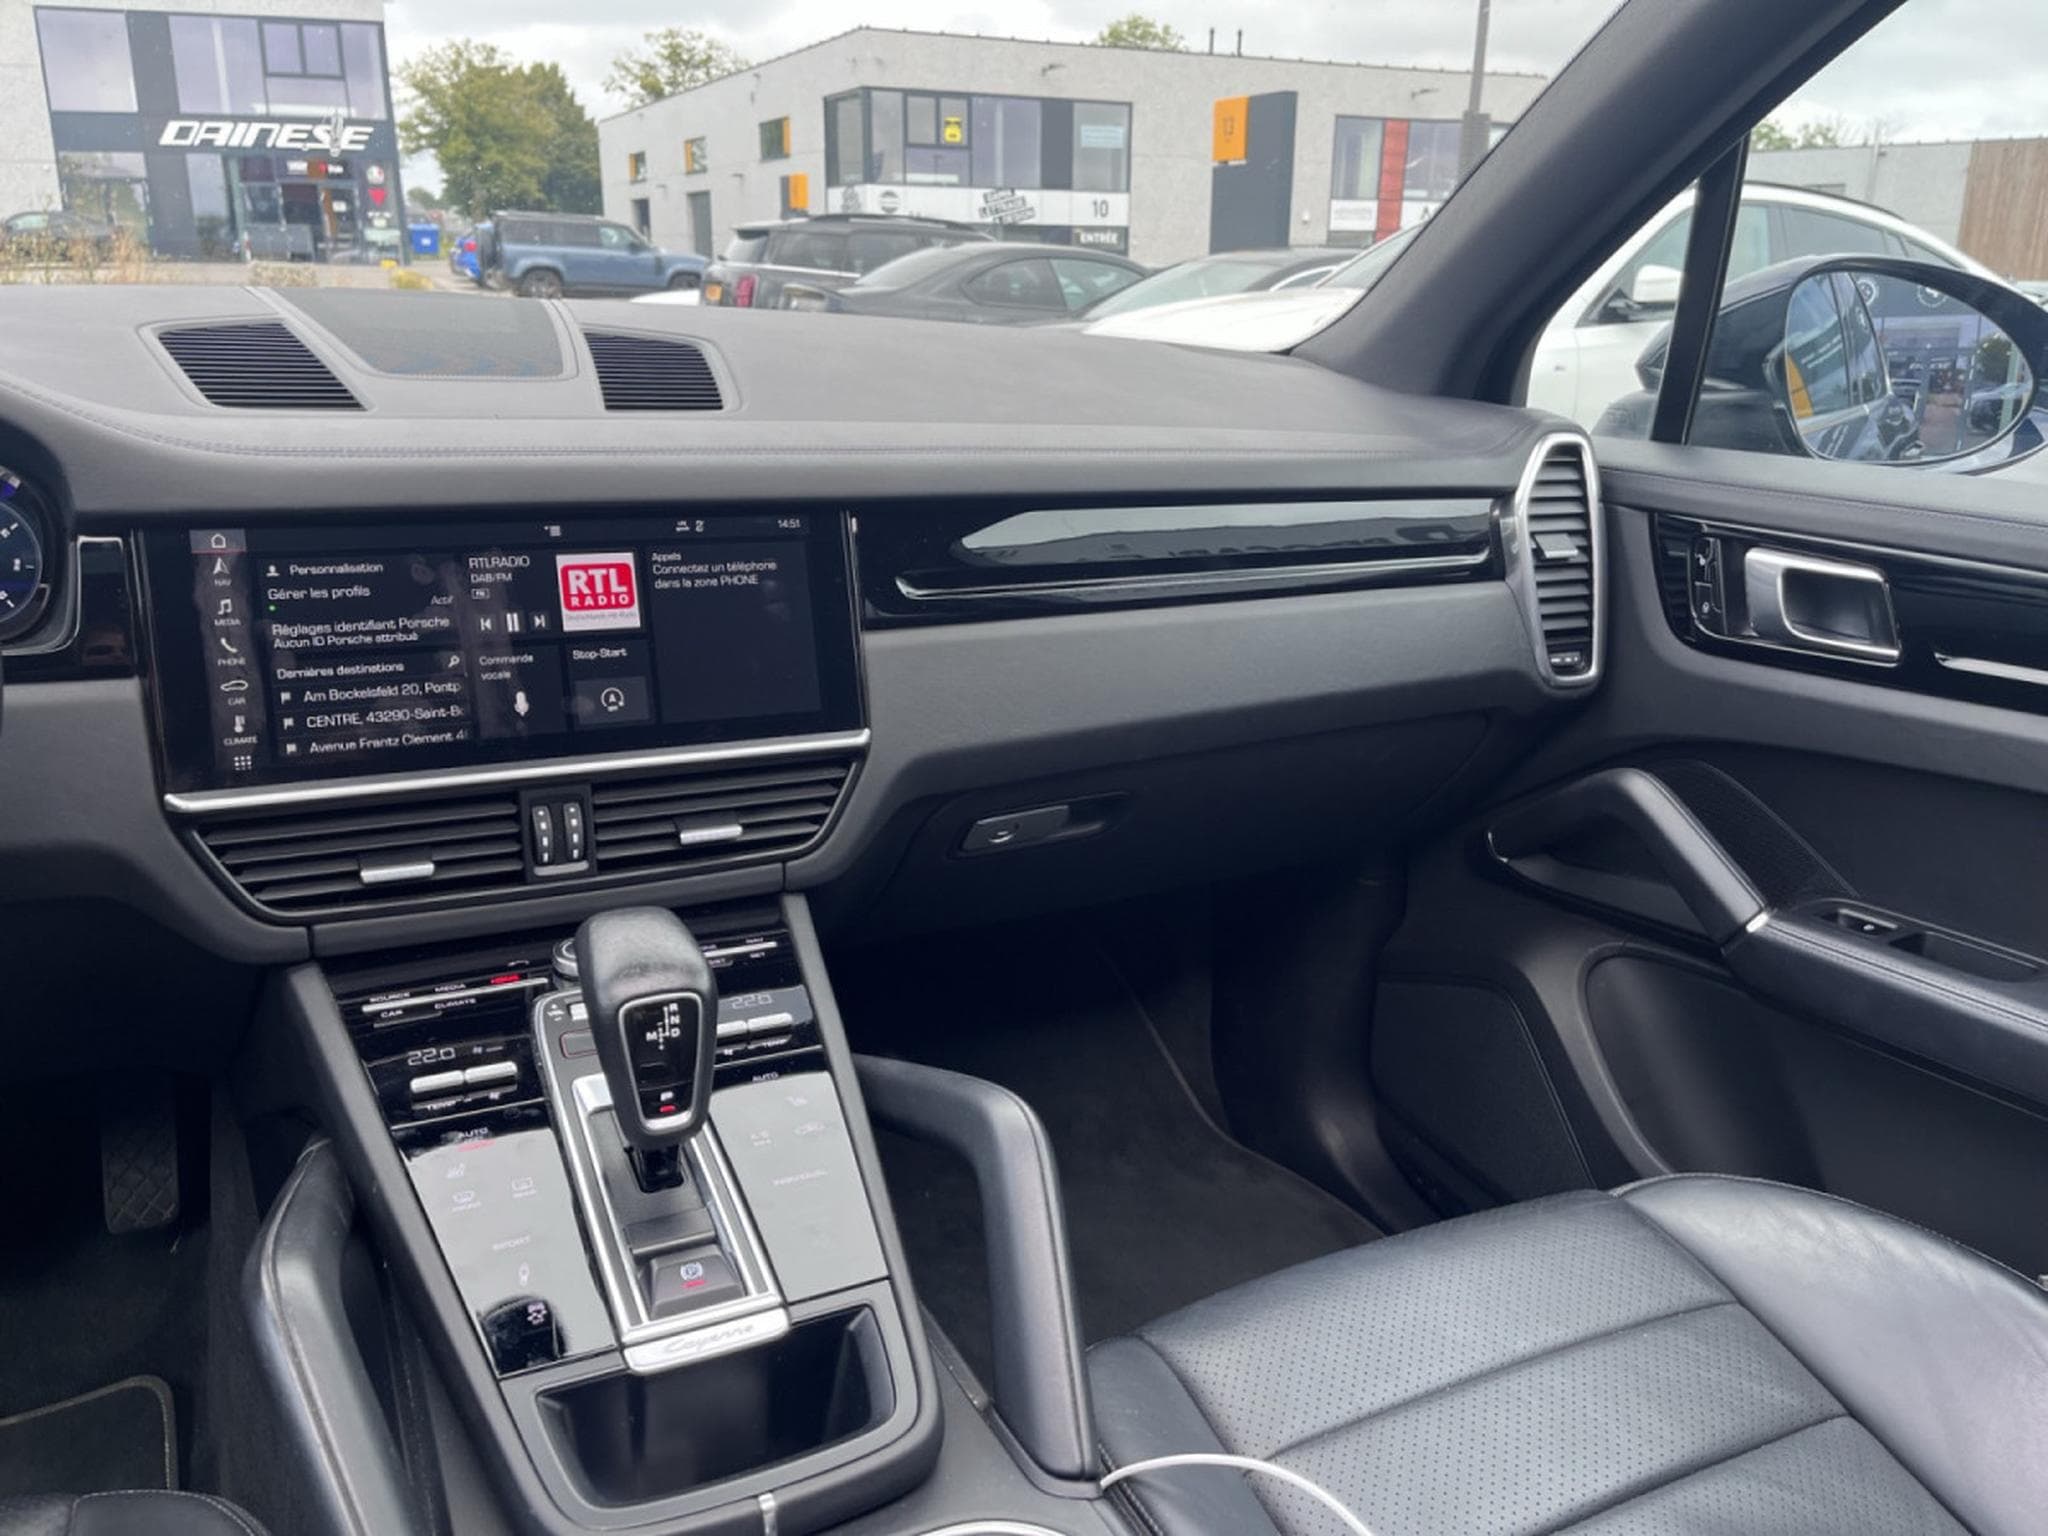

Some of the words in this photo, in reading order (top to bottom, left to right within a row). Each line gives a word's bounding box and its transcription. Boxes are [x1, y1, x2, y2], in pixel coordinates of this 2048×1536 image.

[159, 120, 374, 152] DAINESE
[1093, 199, 1109, 217] 10
[289, 563, 384, 576] Personnalisation
[653, 564, 709, 575] Connectez
[711, 564, 725, 572] un
[726, 560, 777, 573] téléphone
[567, 568, 628, 595] RTL
[654, 578, 680, 589] dans
[682, 578, 692, 588] la
[694, 578, 718, 588] zone
[720, 574, 759, 586] PHONE
[267, 587, 306, 601] Gérer
[310, 586, 328, 599] les
[332, 584, 371, 600] profils
[570, 594, 629, 607] RADIO
[214, 618, 241, 627] MEDIA
[272, 622, 332, 638] Réglages
[334, 619, 397, 633] identifiant
[399, 616, 450, 629] Porsche
[273, 636, 310, 649] Aucun
[312, 635, 324, 647] ID
[327, 633, 373, 646] Porsche
[479, 653, 534, 666] Commande
[573, 647, 628, 660] Stop-Start
[217, 657, 246, 667] PHONE
[276, 665, 334, 681] Dernières
[336, 662, 404, 676] destinations
[481, 670, 511, 681] vocale
[227, 697, 246, 706] CAR
[303, 690, 327, 703] Am
[223, 735, 258, 747] CLIMATE
[309, 740, 357, 754] Avenue
[360, 736, 400, 750] Frantz
[402, 732, 453, 746] Clement
[434, 982, 466, 993] MEDIA
[380, 1009, 404, 1018] CAR
[669, 1003, 679, 1012] R
[670, 1015, 681, 1025] N
[646, 1031, 658, 1041] M
[670, 1027, 681, 1038] D
[407, 1046, 457, 1067] 22.0
[751, 1071, 779, 1083] AUTO
[458, 1127, 489, 1139] AUTO
